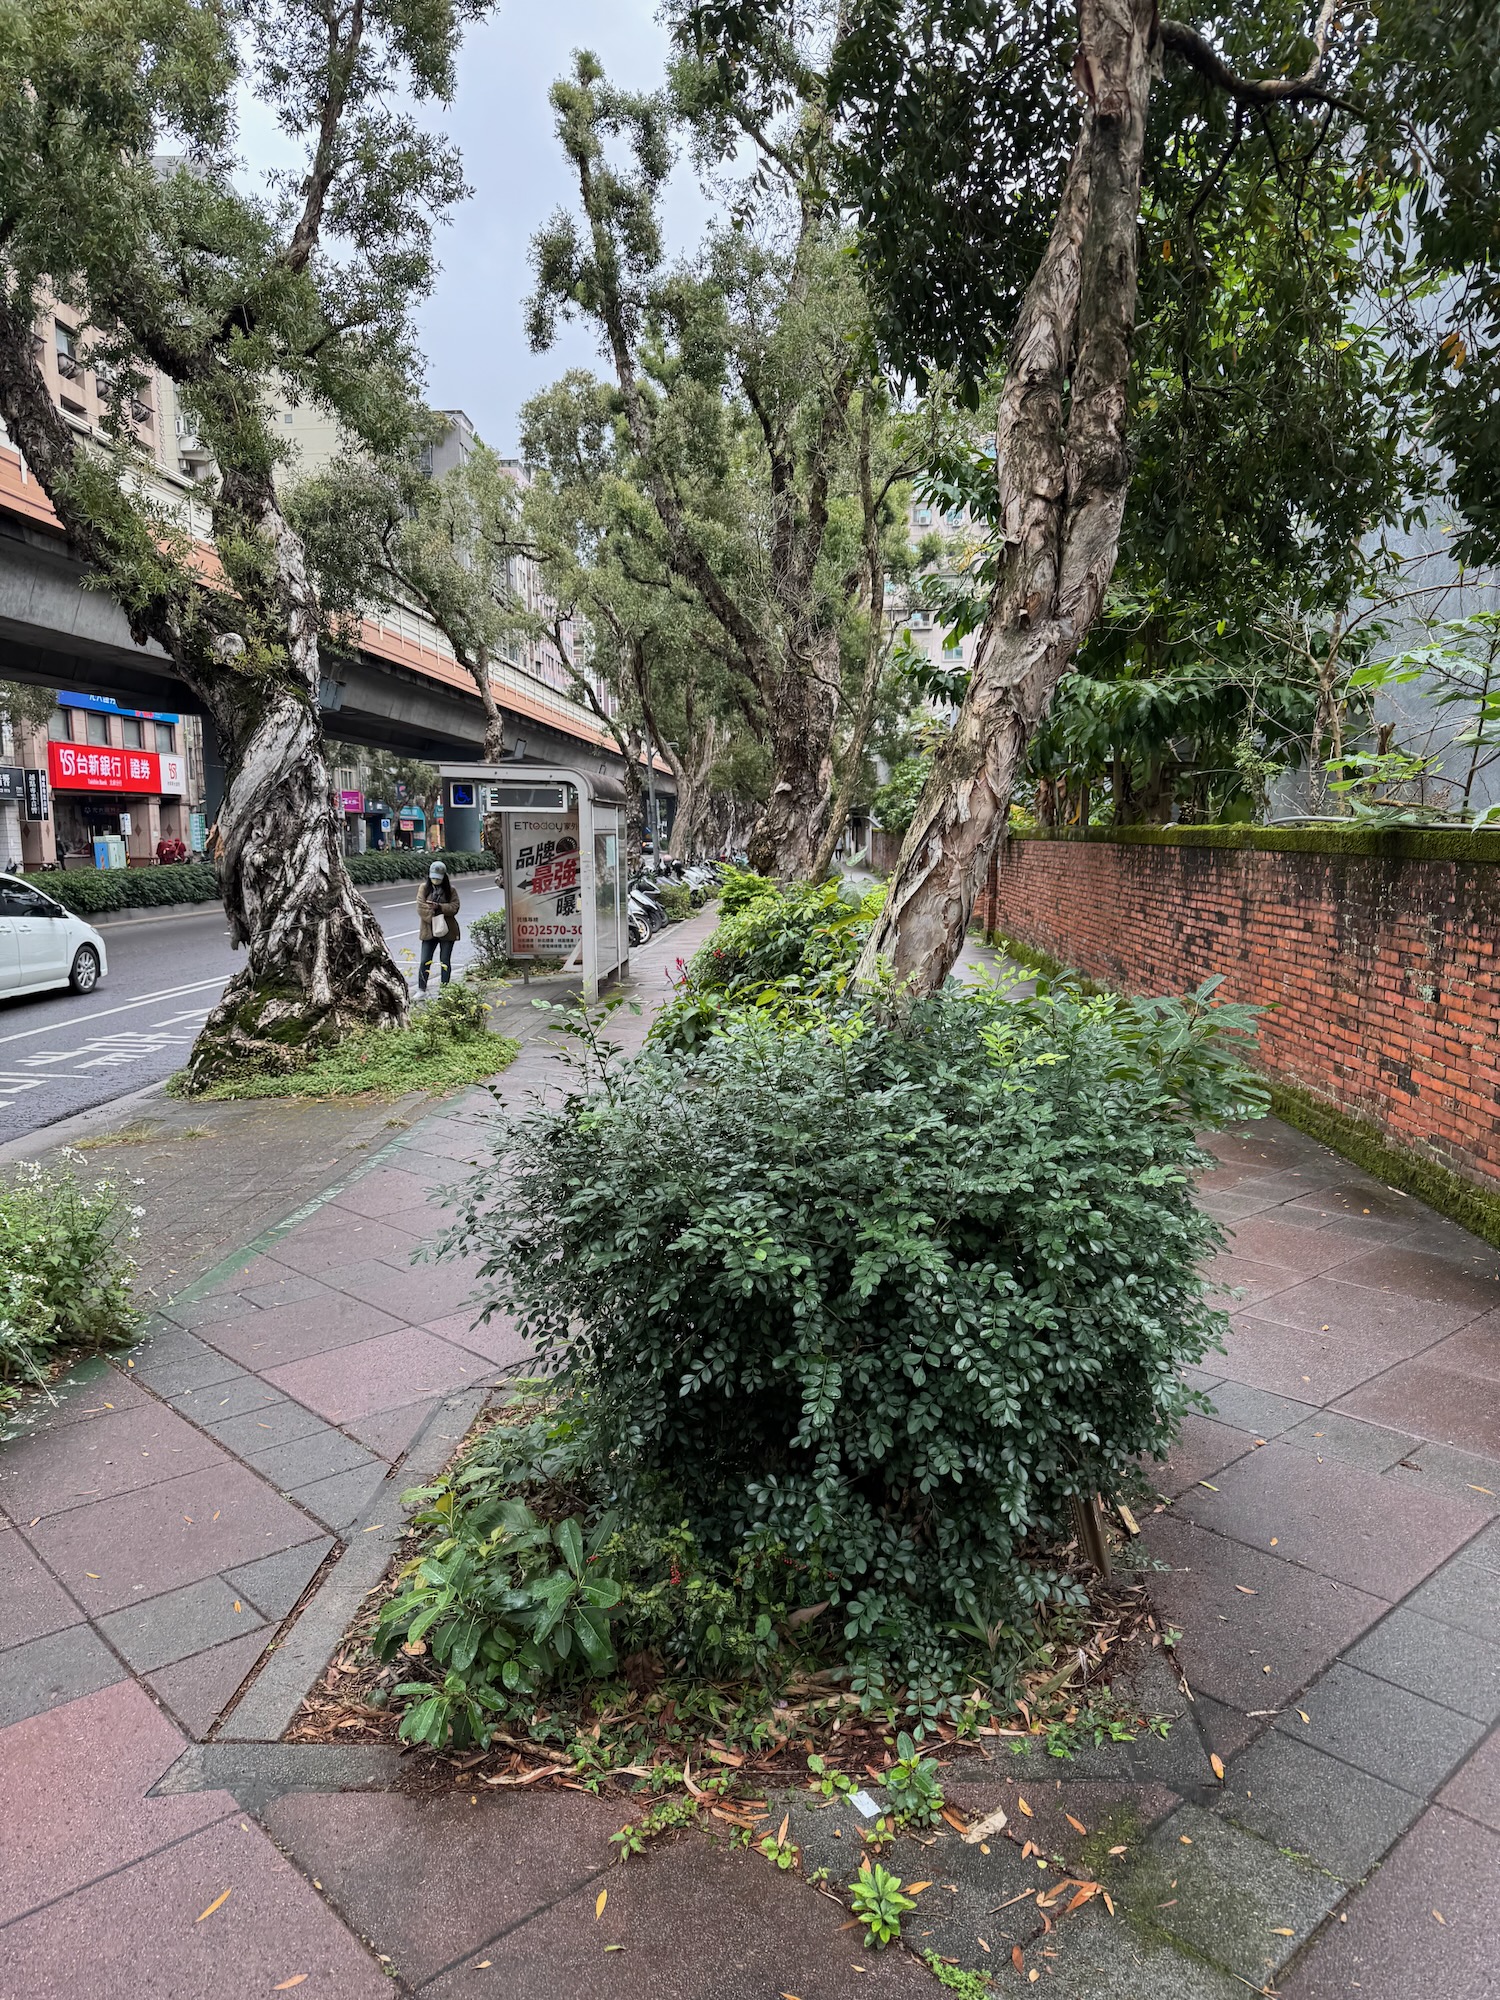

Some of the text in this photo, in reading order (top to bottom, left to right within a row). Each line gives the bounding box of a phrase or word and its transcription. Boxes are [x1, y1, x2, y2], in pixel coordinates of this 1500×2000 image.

[76, 753, 121, 777] 台新銀行
[516, 841, 555, 870] 品牌
[530, 858, 577, 895] 最強
[556, 893, 582, 916] 曝
